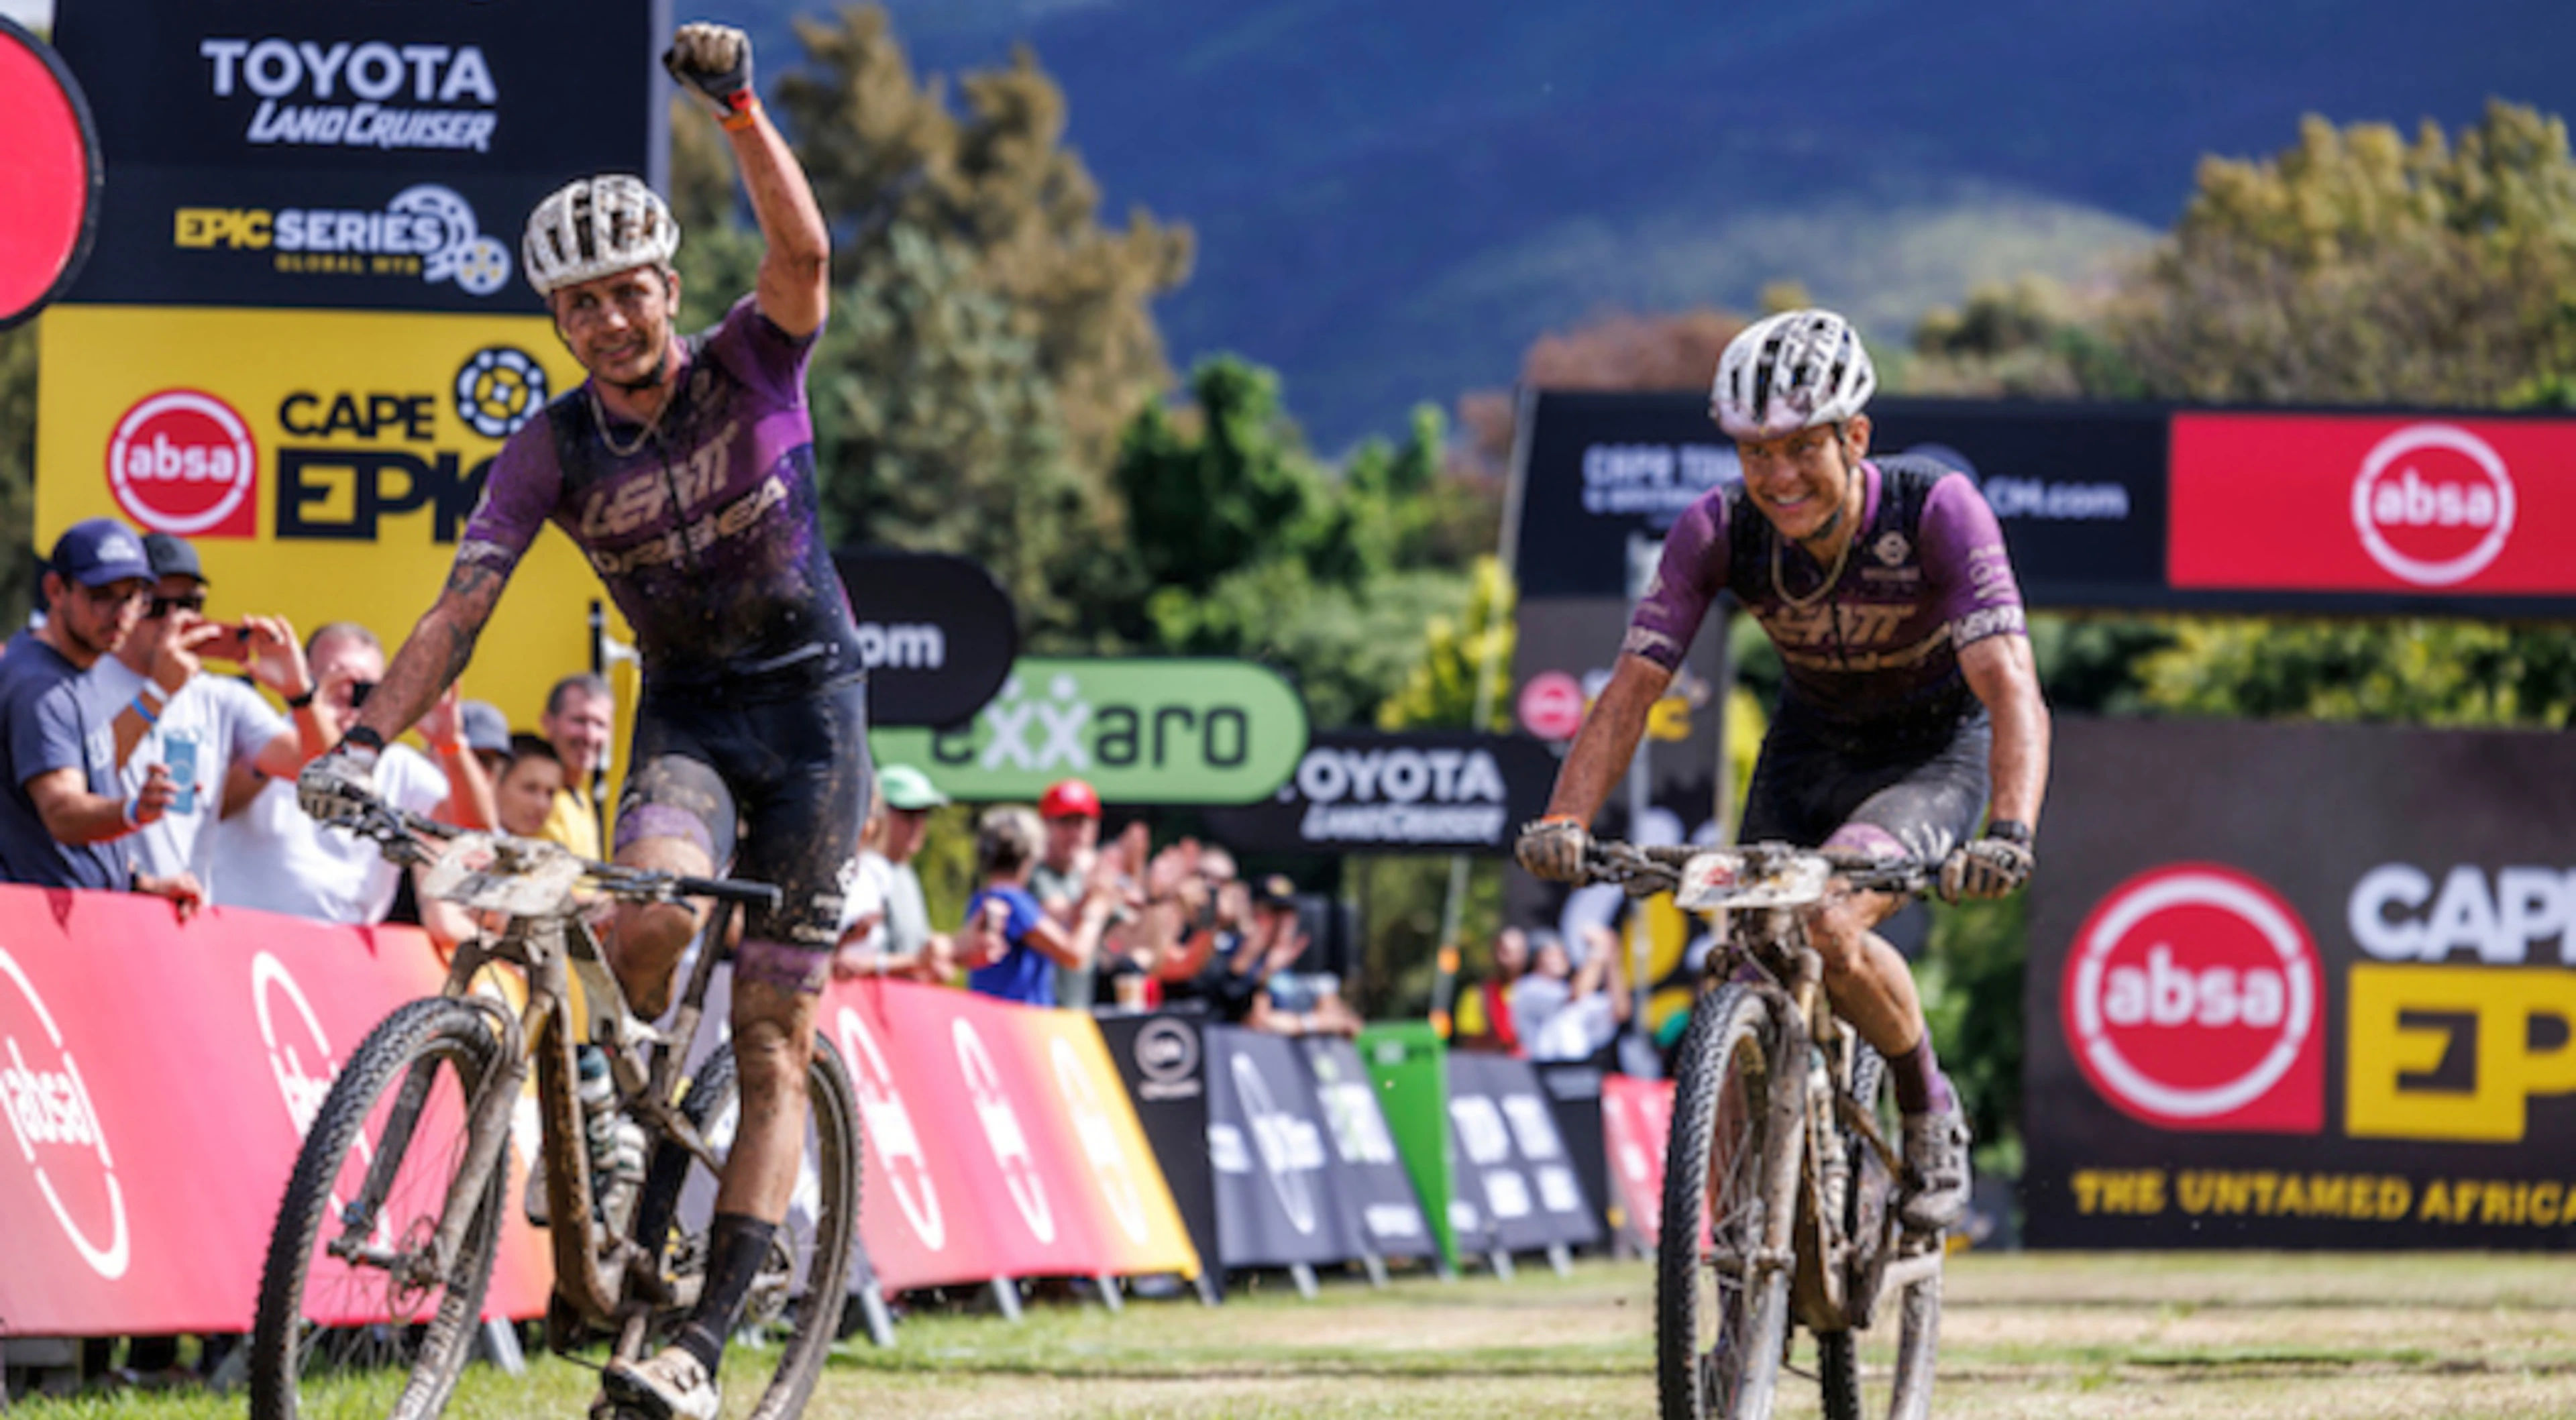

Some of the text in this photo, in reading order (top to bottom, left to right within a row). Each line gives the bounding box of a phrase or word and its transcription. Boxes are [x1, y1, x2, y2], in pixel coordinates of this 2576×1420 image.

[201, 40, 497, 103] TOYOTA
[174, 209, 440, 254] EPIC SERIES
[274, 252, 421, 275] GLOBAL MTB
[278, 389, 437, 441] CAPE
[127, 434, 235, 482] absa
[2373, 468, 2497, 526] absa
[1277, 746, 1507, 804] OYOTA
[2103, 943, 2284, 1029] absa
[2071, 1168, 2167, 1215] THE
[2178, 1170, 2413, 1223] UNTAMED
